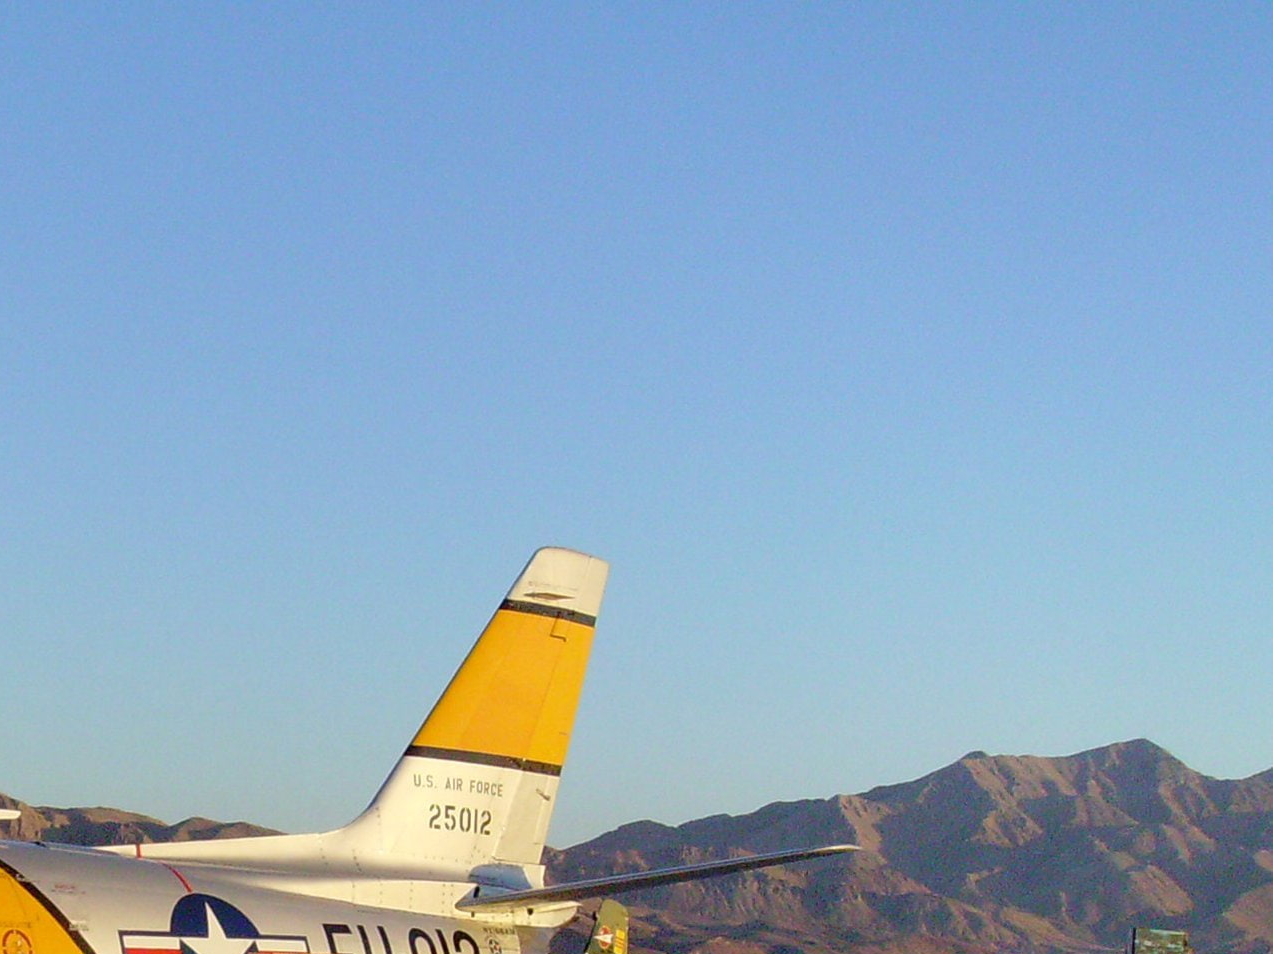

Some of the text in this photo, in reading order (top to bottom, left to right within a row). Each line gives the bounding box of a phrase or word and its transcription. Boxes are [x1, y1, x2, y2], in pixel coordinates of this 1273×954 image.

[413, 773, 504, 797] U.S. AIR FORCE
[428, 803, 492, 836] 25012
